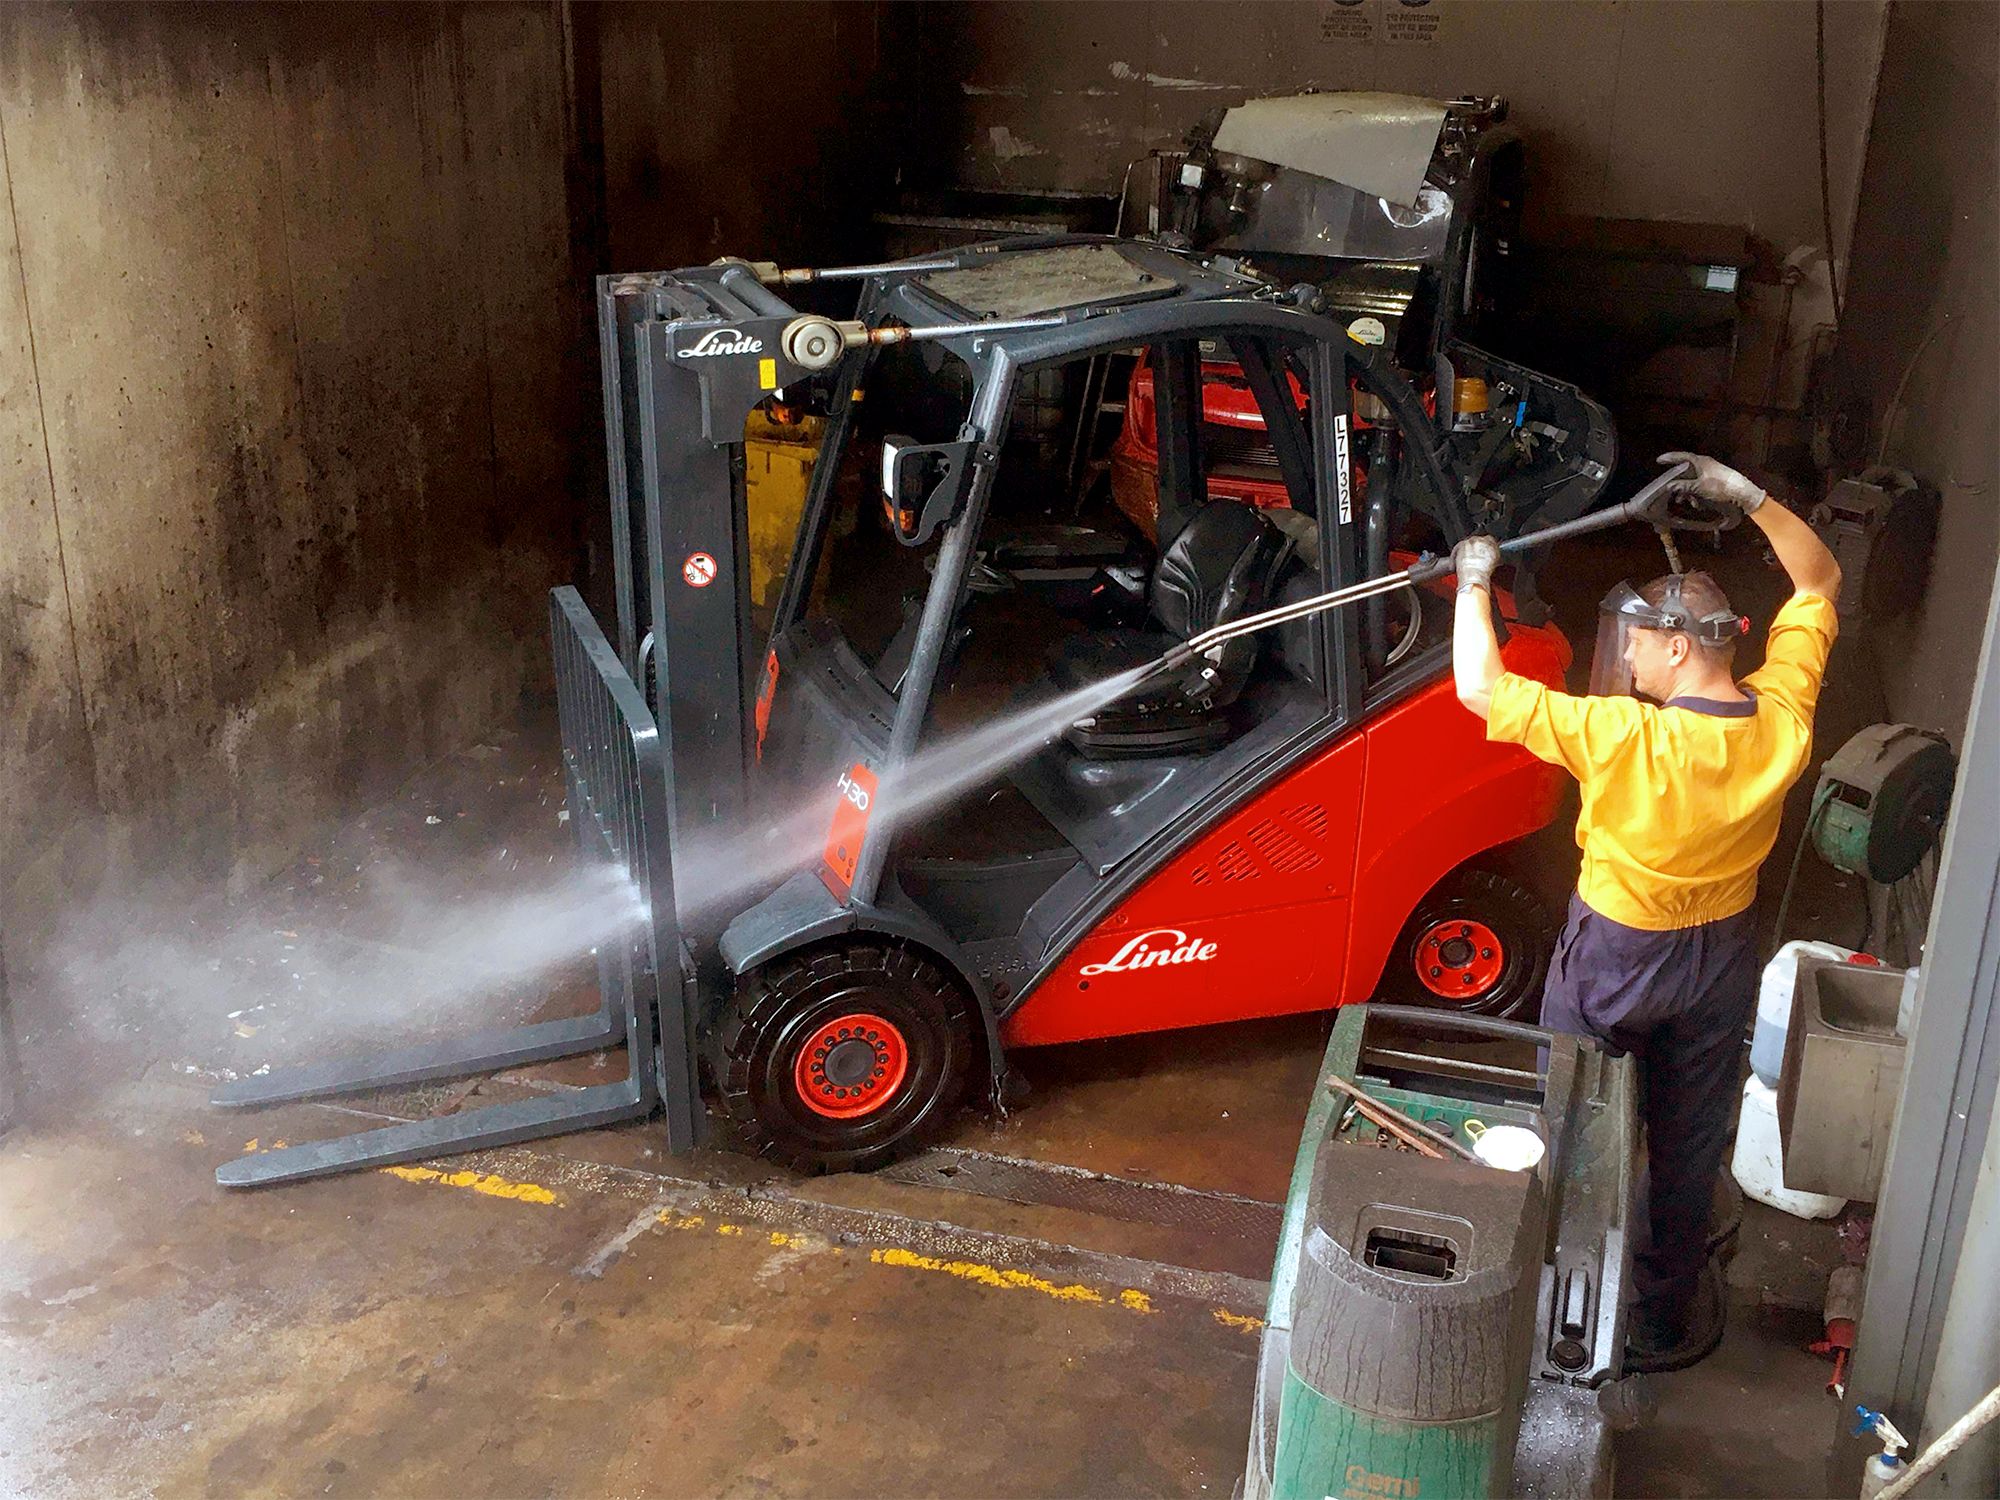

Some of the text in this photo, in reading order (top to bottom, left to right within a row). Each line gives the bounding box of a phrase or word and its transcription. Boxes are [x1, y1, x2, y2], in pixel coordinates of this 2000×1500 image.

[1400, 13, 1440, 22] PROTECTION
[677, 329, 763, 358] Linde
[1336, 417, 1349, 523] L77327
[837, 772, 869, 811] H30
[1079, 929, 1218, 976] Linde
